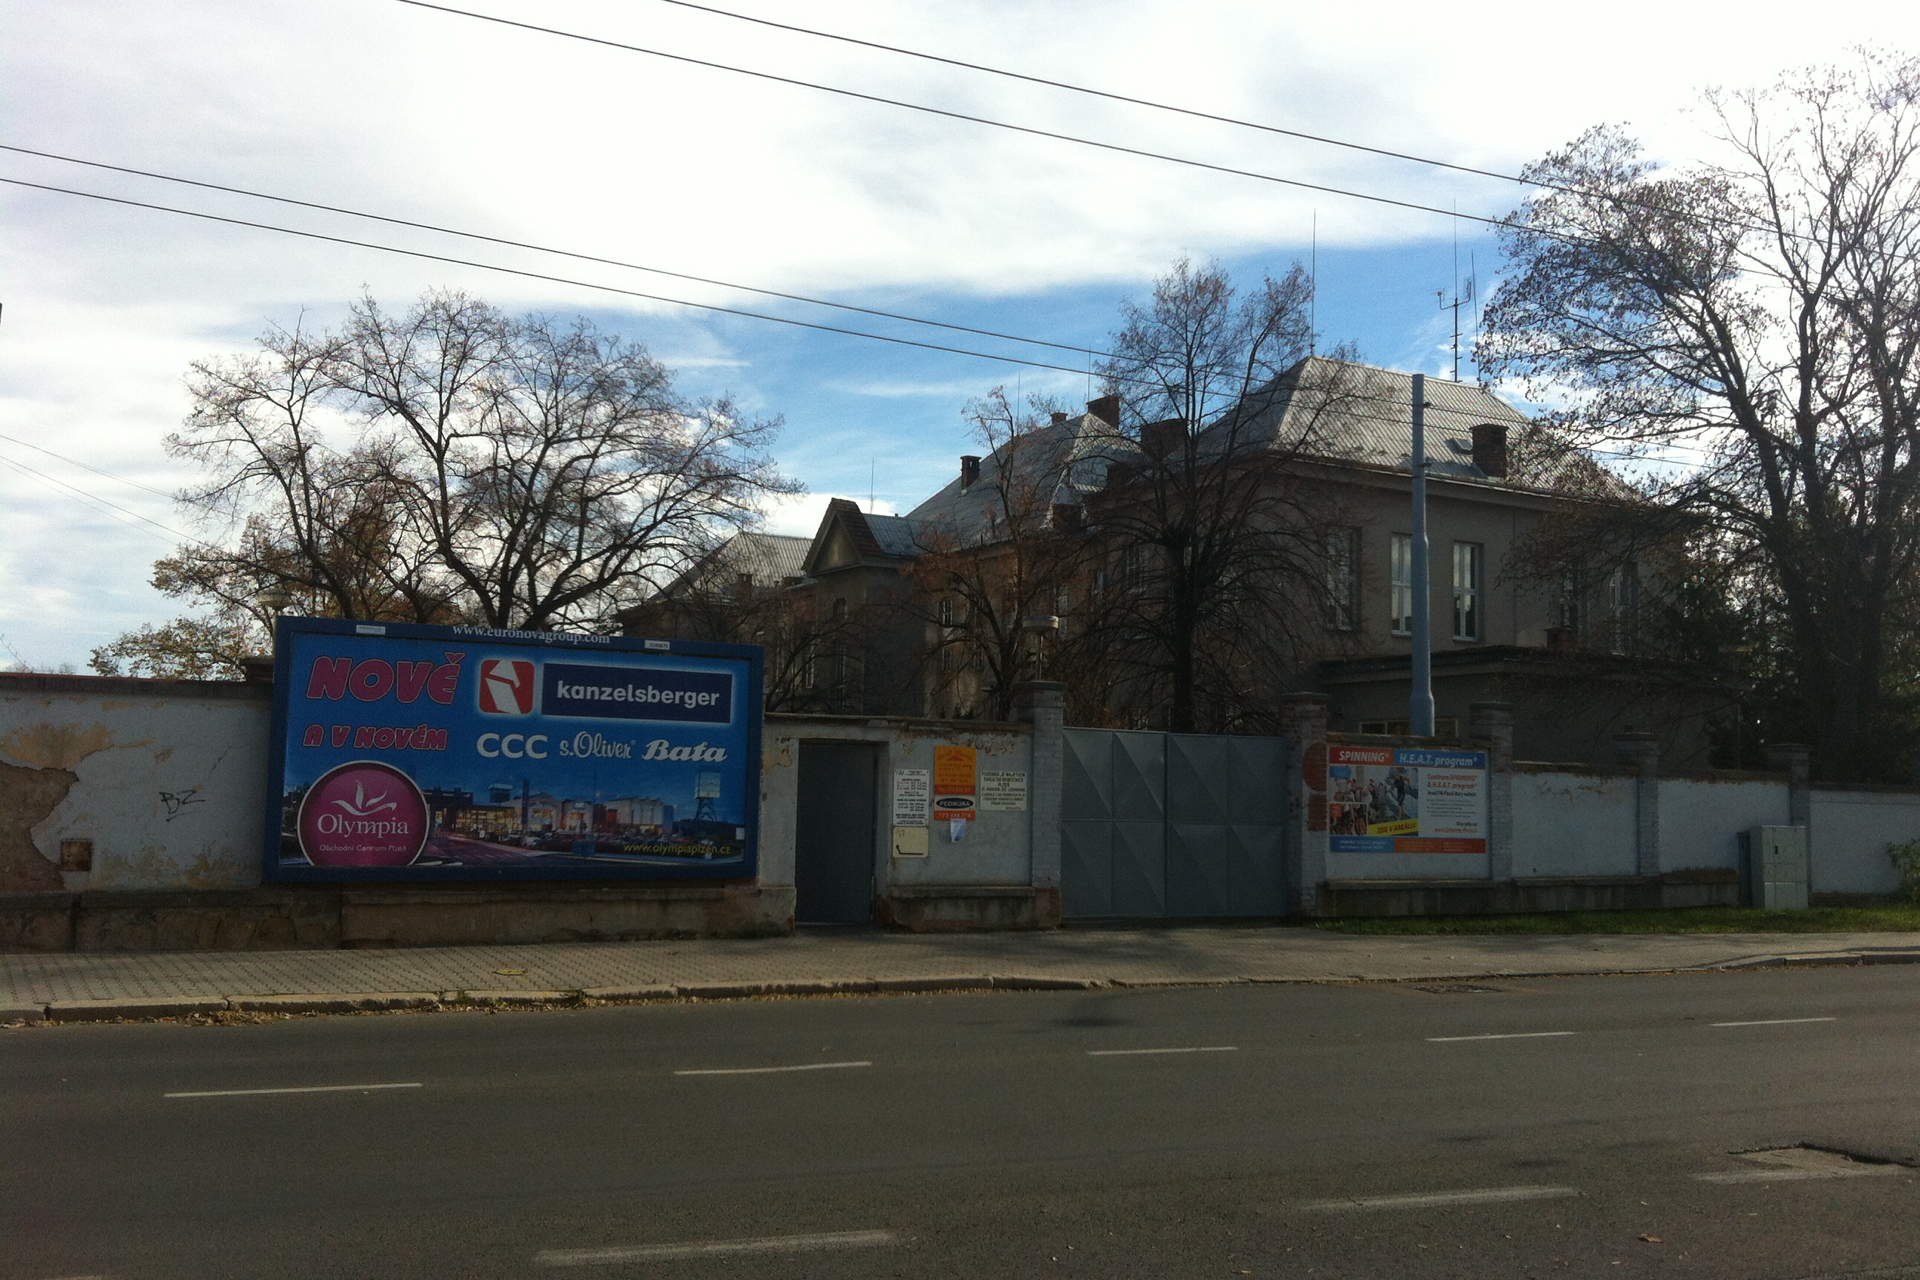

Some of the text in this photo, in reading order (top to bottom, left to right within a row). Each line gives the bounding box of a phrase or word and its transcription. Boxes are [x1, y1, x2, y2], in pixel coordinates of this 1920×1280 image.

[452, 624, 610, 645] www.euronovagroup.com
[305, 651, 466, 705] NOVĚ
[557, 680, 720, 709] kanzelsberger
[303, 723, 449, 751] A V NOVÉM
[476, 732, 549, 760] CCC
[317, 813, 409, 838] Olympia
[319, 844, 407, 852] Obchodní Centrum Plzeň
[624, 843, 731, 856] www.olympiaplzen.cz
